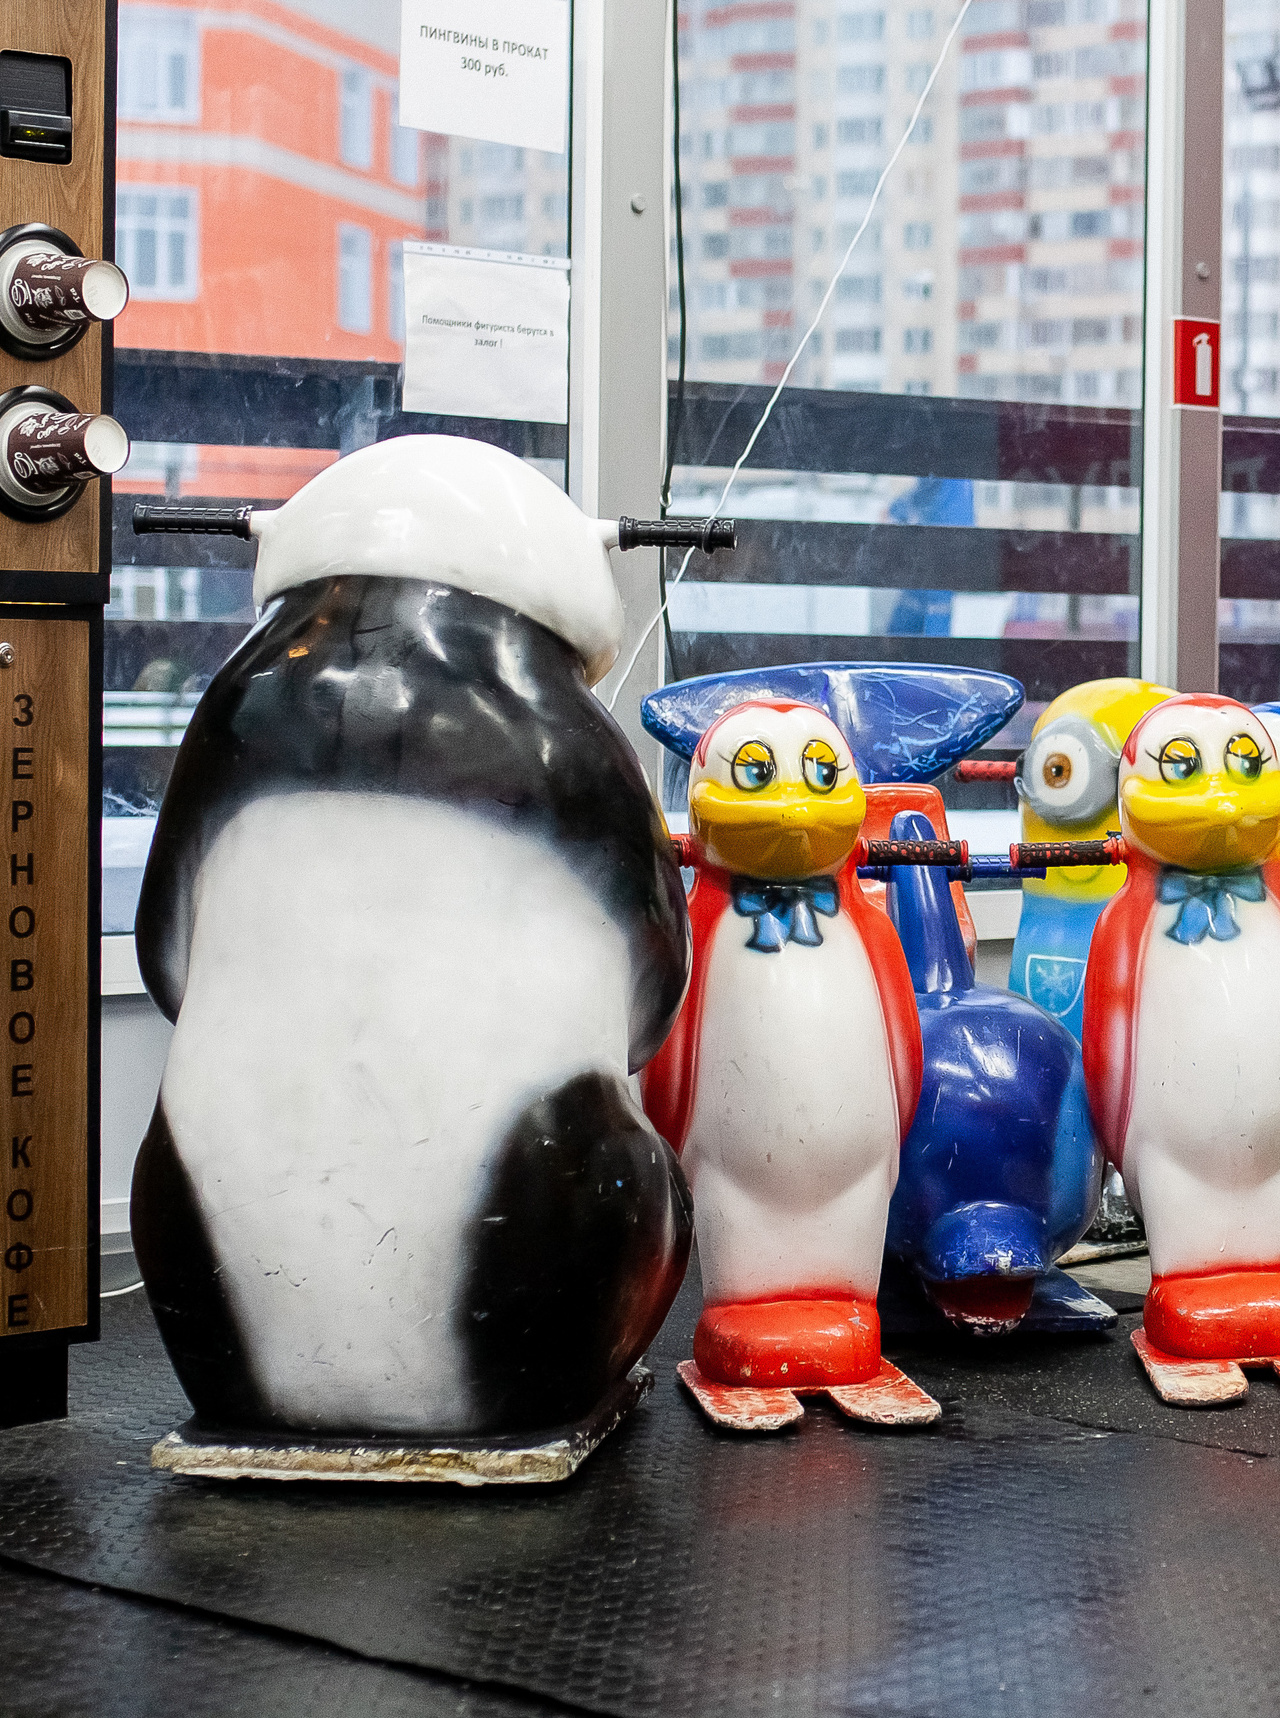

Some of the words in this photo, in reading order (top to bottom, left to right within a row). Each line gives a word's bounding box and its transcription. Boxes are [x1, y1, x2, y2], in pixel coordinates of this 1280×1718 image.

[419, 25, 489, 50] ПИНГВИНЫ
[492, 38, 499, 51] В
[502, 40, 549, 61] ПРОКАТ
[460, 56, 482, 72] 300
[484, 63, 509, 78] руб.
[421, 314, 473, 330] Помощники
[474, 320, 515, 334] фигуриста
[474, 337, 499, 348] залог
[8, 693, 36, 1097] ЗЕРНОВОЕ
[4, 1135, 35, 1328] КОФЕ
